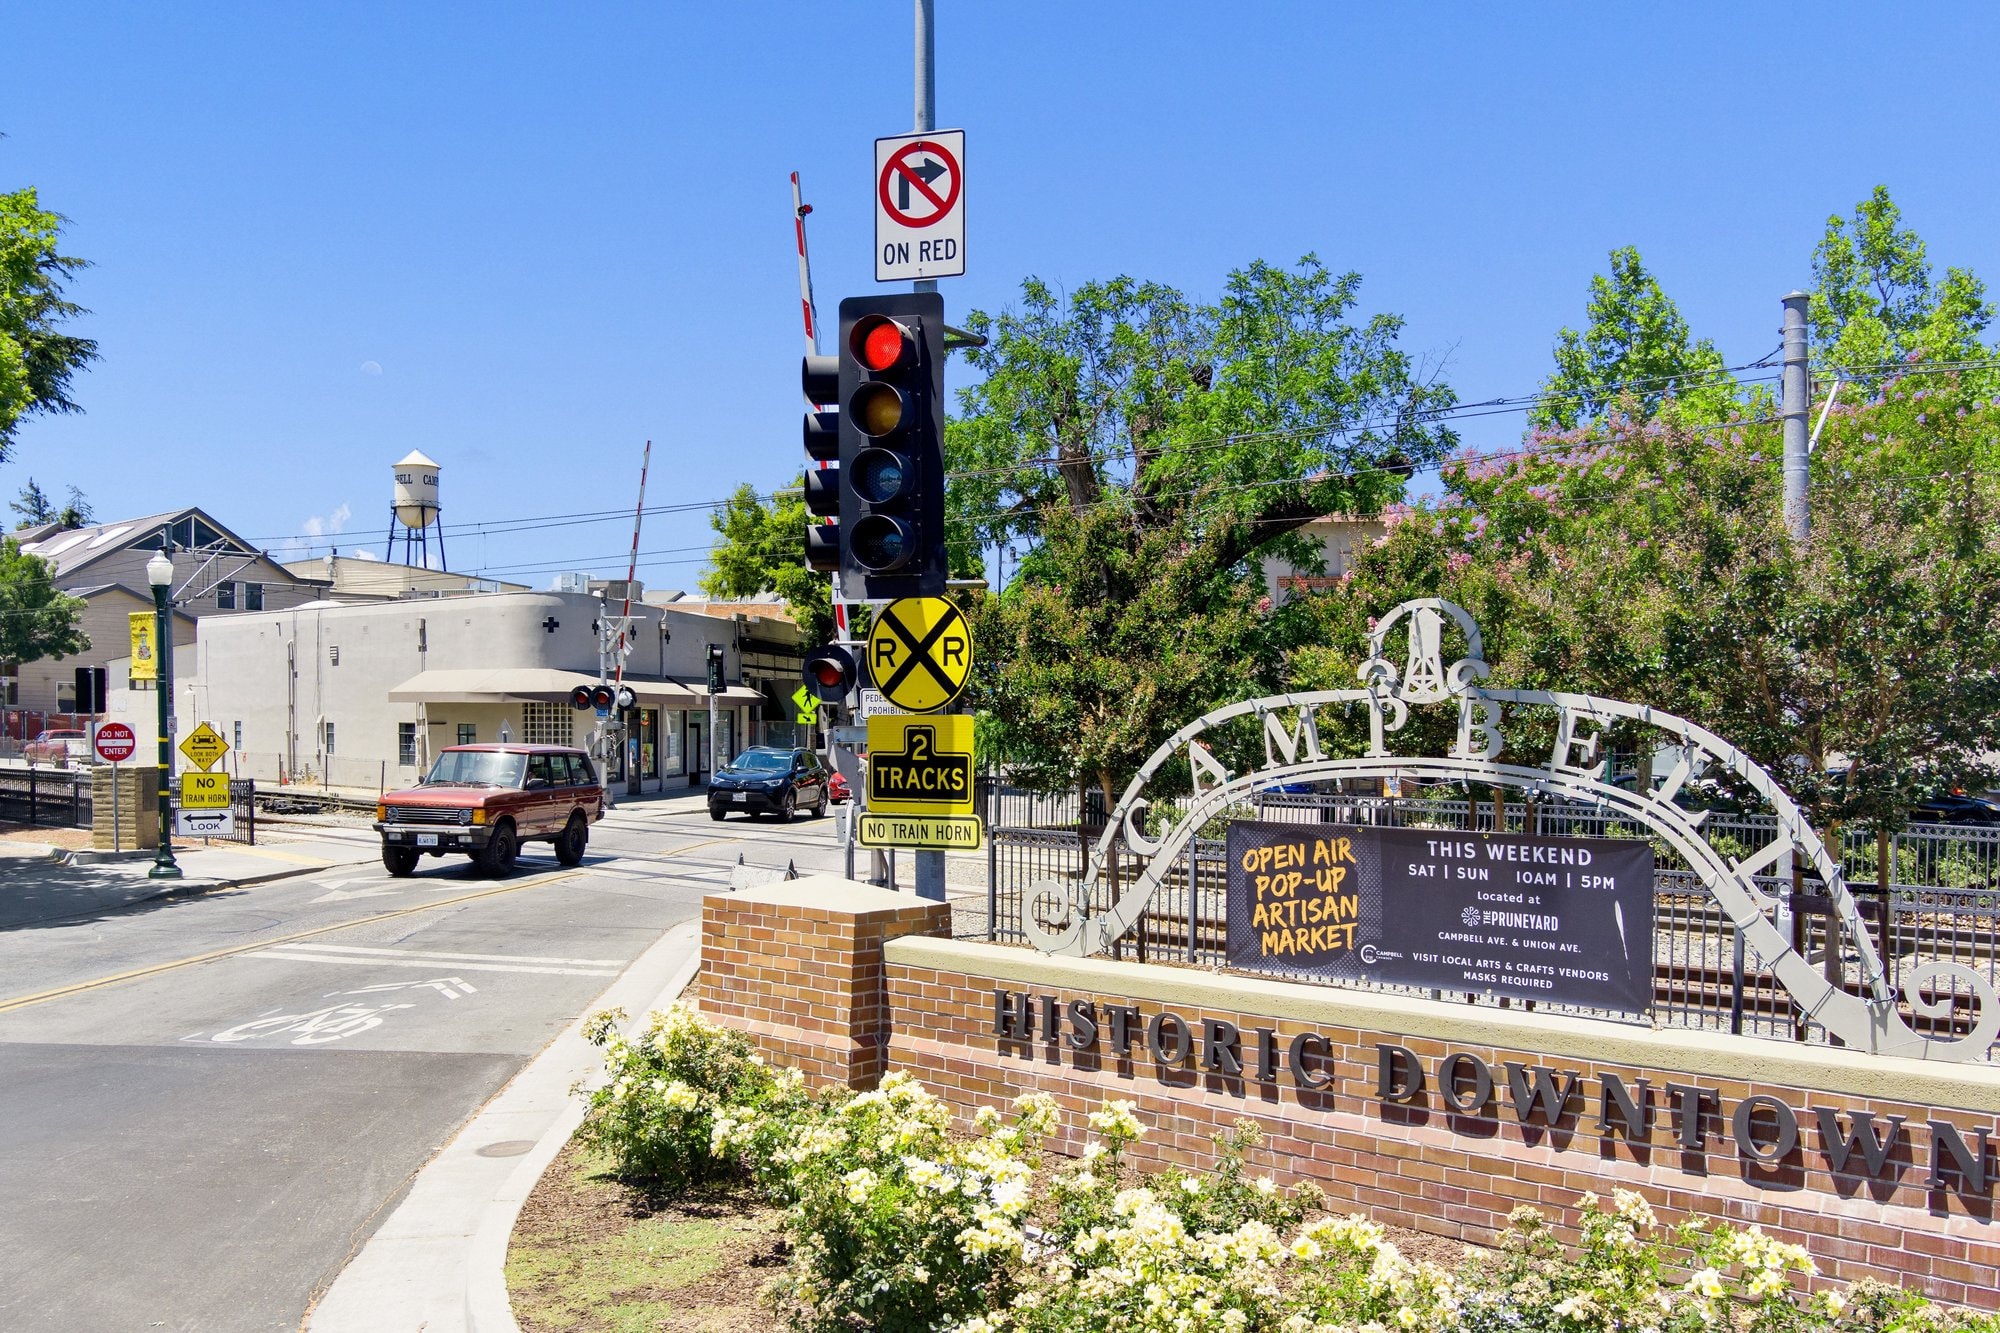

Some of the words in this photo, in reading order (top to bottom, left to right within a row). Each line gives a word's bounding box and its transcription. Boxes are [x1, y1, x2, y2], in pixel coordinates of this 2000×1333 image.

[884, 242, 909, 266] ON
[919, 238, 957, 262] RED
[875, 638, 897, 668] R
[943, 636, 964, 667] R
[912, 734, 928, 761] 2
[196, 778, 215, 788] NO
[876, 766, 964, 791] TRACKS
[185, 794, 205, 803] TRAIN
[208, 794, 227, 803] HORN
[1123, 697, 1794, 911] CAMPBELL
[190, 823, 221, 831] LOOK
[868, 823, 885, 839] NO
[893, 823, 929, 840] TRAIN
[936, 823, 972, 841] HORN
[1242, 843, 1305, 872] OPEN
[1313, 837, 1356, 866] AIR
[1427, 840, 1476, 858] THIS
[1486, 844, 1592, 866] WEEKEND
[1254, 866, 1346, 900] POP-UP
[1408, 864, 1436, 877] SAT
[1457, 867, 1489, 880] SUN
[1516, 871, 1557, 886] 10AM
[1581, 876, 1615, 890] 5PM
[1477, 891, 1523, 903] Located
[1528, 896, 1541, 904] at
[1252, 895, 1358, 930] ARTISAN
[1483, 910, 1491, 924] THE
[1491, 911, 1559, 931] PRUNEYARD
[1262, 922, 1358, 957] MARKET
[1438, 932, 1484, 944] CAMPBELL
[1487, 936, 1508, 946] AVE.
[1512, 939, 1519, 947] &
[1523, 940, 1556, 950] UNION
[1560, 944, 1582, 953] AVE.
[1412, 952, 1439, 962] VISIT
[1442, 956, 1472, 966] LOCAL
[1476, 960, 1501, 969] ARTS
[1505, 962, 1512, 970] &
[1516, 963, 1555, 975] CRAFTS
[1559, 968, 1609, 981] VENDORS
[1464, 971, 1497, 983] MASKS
[1501, 976, 1553, 988] REQUIRED
[992, 987, 1332, 1089] HISTORIC
[1375, 1042, 1994, 1193] DOWNTOWN
